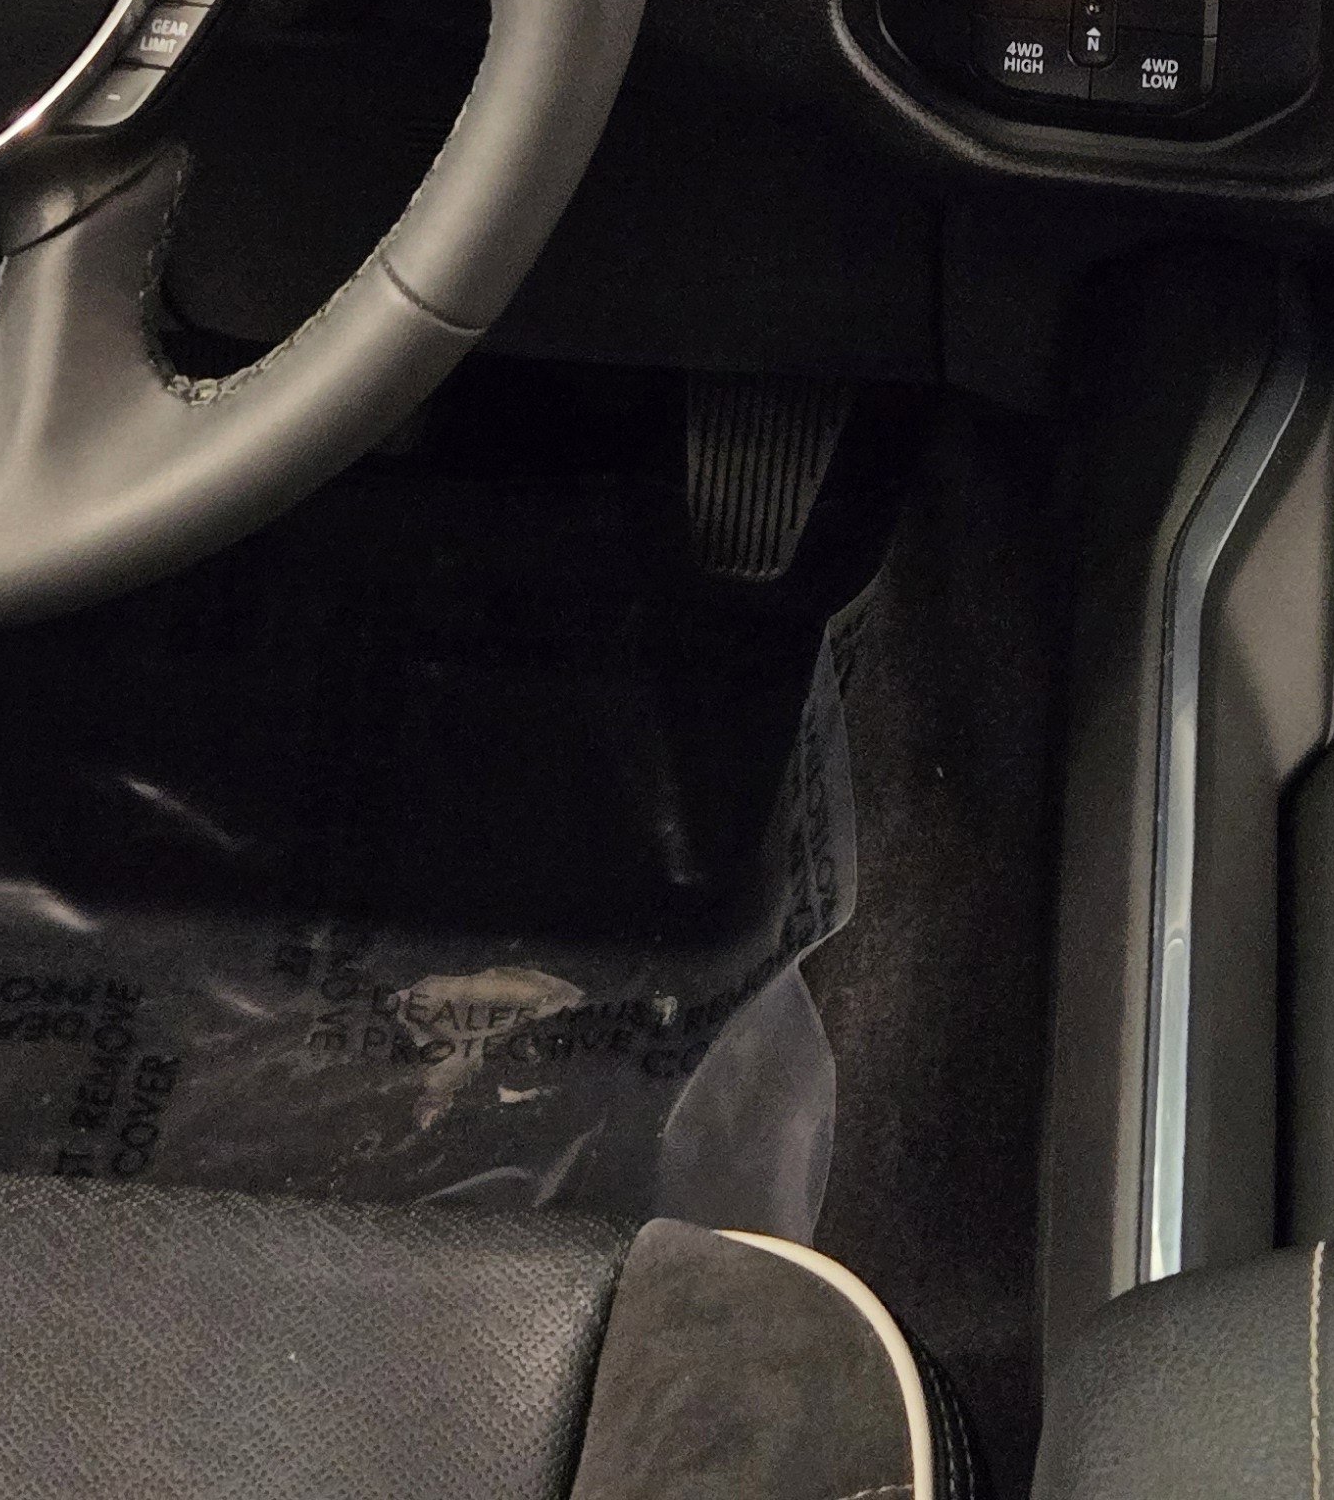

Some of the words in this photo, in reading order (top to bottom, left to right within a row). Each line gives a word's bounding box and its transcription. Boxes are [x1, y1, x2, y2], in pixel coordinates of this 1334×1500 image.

[152, 19, 189, 37] GEAR
[139, 36, 178, 54] LIMIT
[1006, 41, 1044, 58] 4WD
[1087, 37, 1100, 52] N
[1003, 57, 1044, 75] HIGH
[1141, 58, 1179, 74] 4WD
[1141, 73, 1178, 90] LOW
[111, 1055, 182, 1177] COVER
